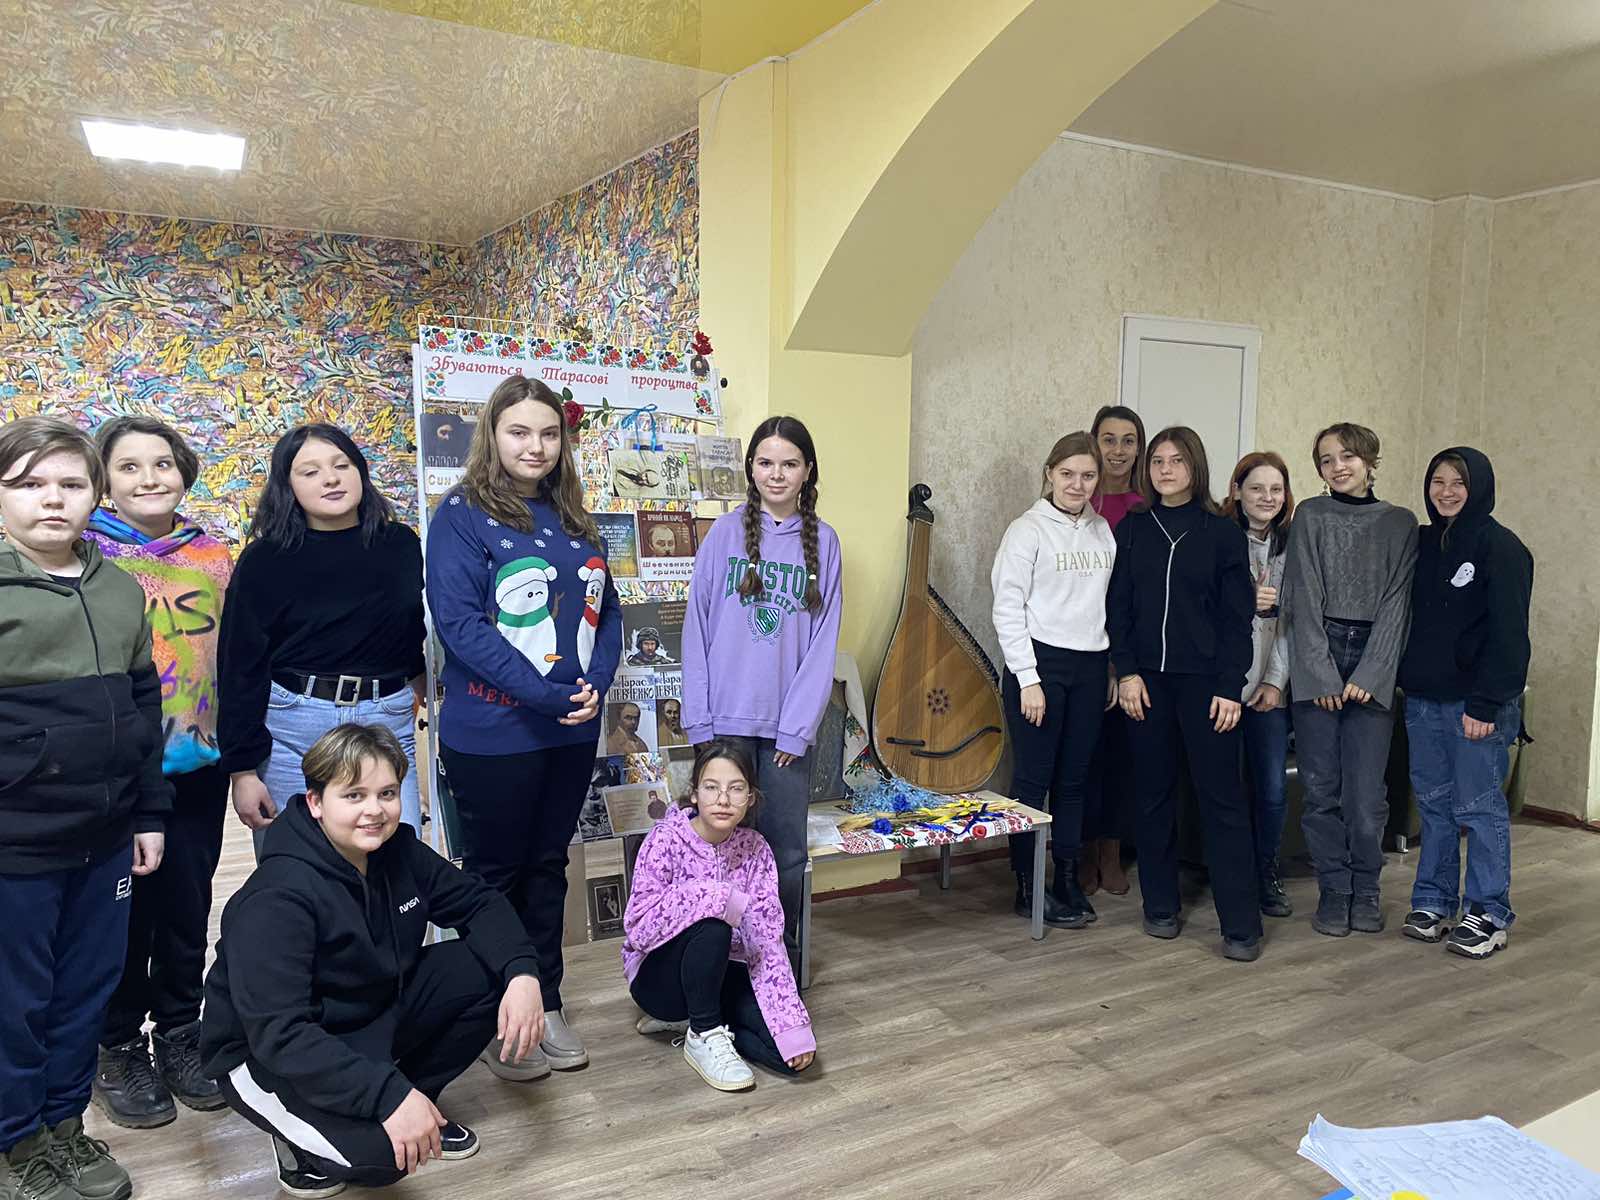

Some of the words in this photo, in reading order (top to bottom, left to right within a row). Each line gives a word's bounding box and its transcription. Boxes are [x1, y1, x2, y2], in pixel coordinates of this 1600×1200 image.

[431, 355, 524, 376] Збуваються
[541, 367, 609, 385] Тарасові
[631, 375, 699, 391] пророцтва
[467, 681, 521, 707] MER
[399, 896, 420, 914] NASA
